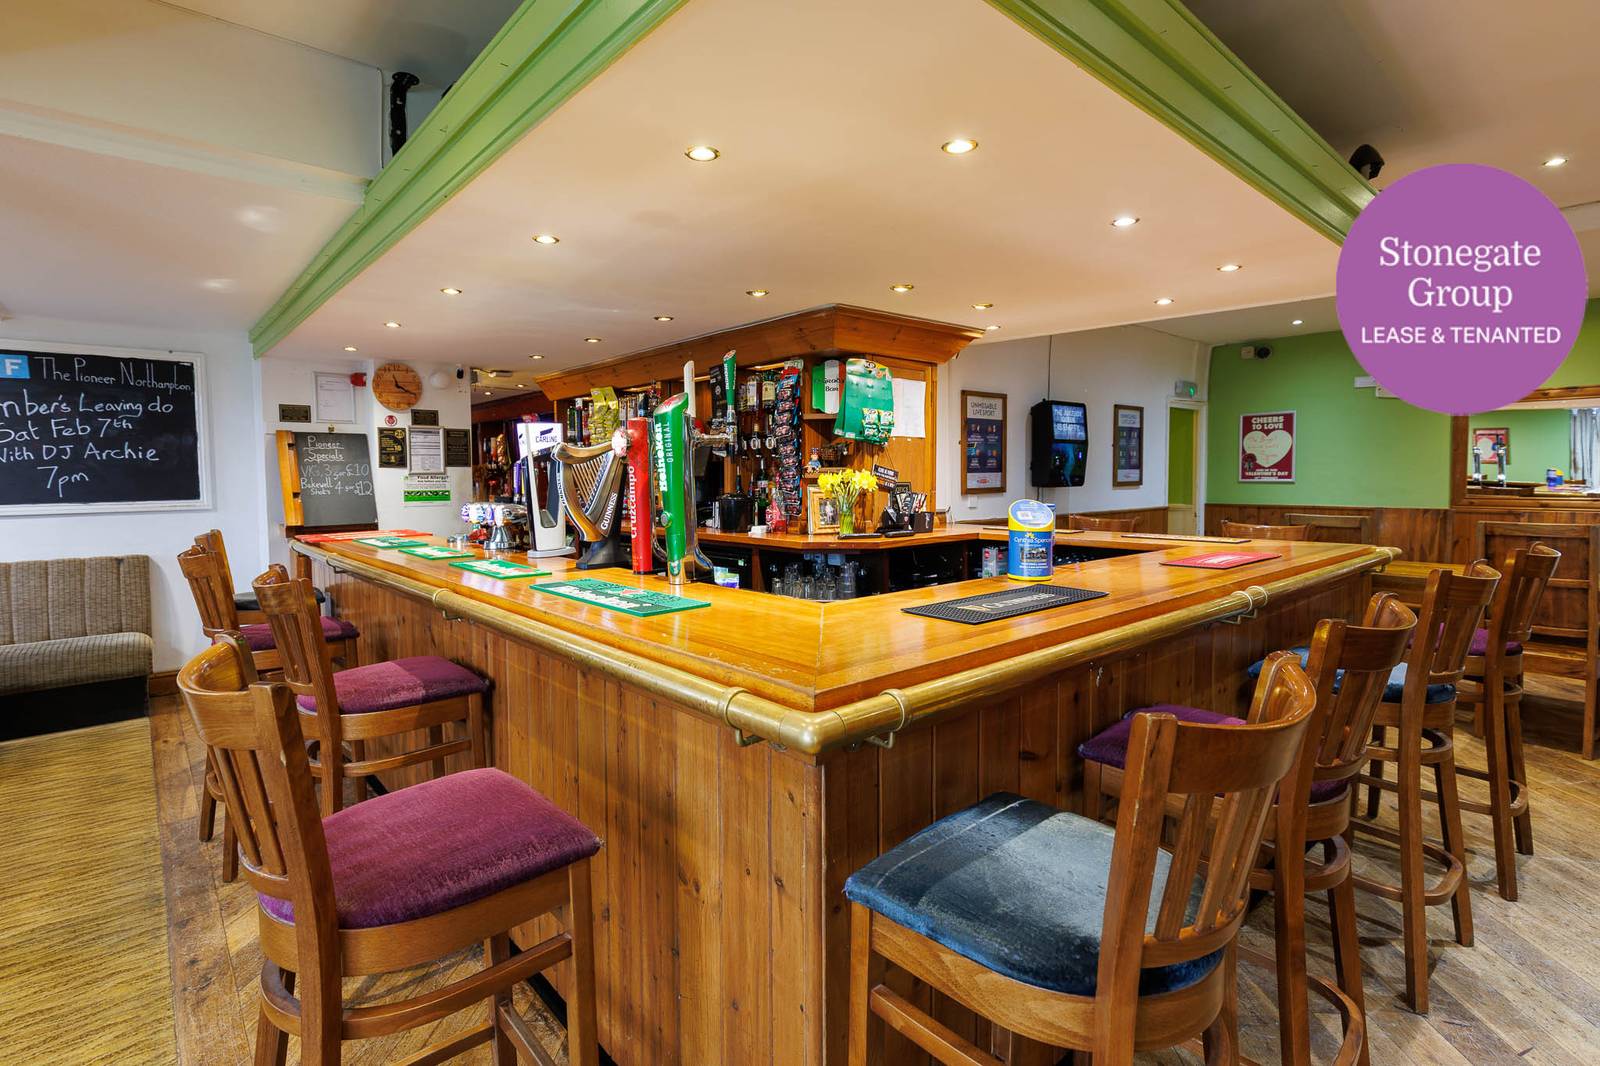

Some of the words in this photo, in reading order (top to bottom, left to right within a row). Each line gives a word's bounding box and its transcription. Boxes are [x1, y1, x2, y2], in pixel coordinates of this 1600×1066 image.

[33, 356, 71, 382] The
[74, 357, 116, 384] Pioneer
[120, 361, 192, 395] Northampton
[79, 392, 144, 418] Leaving
[148, 395, 174, 414] do
[0, 420, 39, 443] Sat
[51, 418, 91, 438] Feb
[97, 418, 133, 438] 7th
[1251, 416, 1284, 424] CHEERS
[307, 435, 342, 450] Pioneer
[535, 435, 558, 443] CARLING
[665, 422, 674, 463] ORIGINAL
[42, 445, 74, 460] DJ
[83, 442, 160, 461] Archie
[308, 449, 344, 464] Specials
[324, 464, 332, 476] 3
[36, 466, 89, 498] 7pm
[335, 481, 344, 495] 4
[600, 493, 618, 530] GUINNESS
[627, 465, 638, 539] cruzcampo
